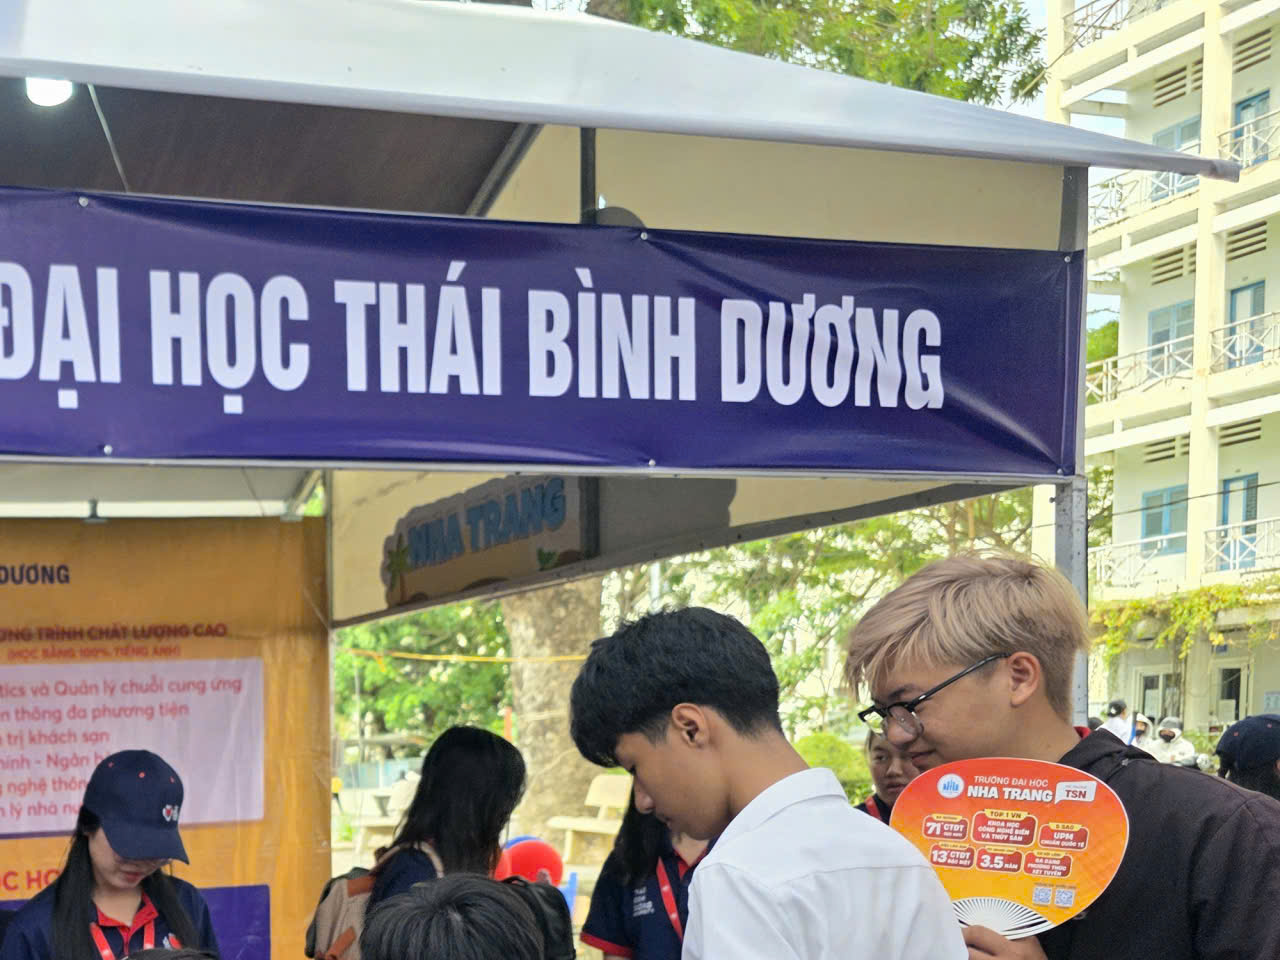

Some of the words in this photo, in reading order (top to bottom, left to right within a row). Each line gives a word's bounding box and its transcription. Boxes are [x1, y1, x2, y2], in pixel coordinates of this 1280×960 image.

[149, 269, 310, 414] HỌC
[334, 260, 502, 395] THÁI
[527, 267, 696, 401] BÌNH
[720, 293, 944, 410] DƯƠNG
[464, 477, 566, 553] TRANG
[36, 624, 84, 641] TRÌNH
[193, 622, 228, 638] CAO
[30, 682, 50, 699] và
[54, 680, 99, 699] Quản
[120, 674, 164, 695] chuỗi
[167, 678, 207, 696] cung
[210, 675, 243, 694] ứng
[14, 704, 62, 724] thông
[66, 703, 87, 720] đa
[91, 702, 155, 722] phương
[158, 701, 190, 719] tiện
[28, 729, 76, 745] khách
[82, 730, 110, 747] sạn
[46, 753, 89, 772] Ngân
[7, 777, 48, 797] nghệ
[52, 775, 87, 792] thôn
[973, 775, 1009, 786] TRƯỜNG
[967, 785, 999, 799] NHA
[1002, 787, 1054, 803] TRANG
[1065, 789, 1087, 799] TSN
[27, 801, 58, 817] nhà
[980, 854, 1004, 868] 3.5
